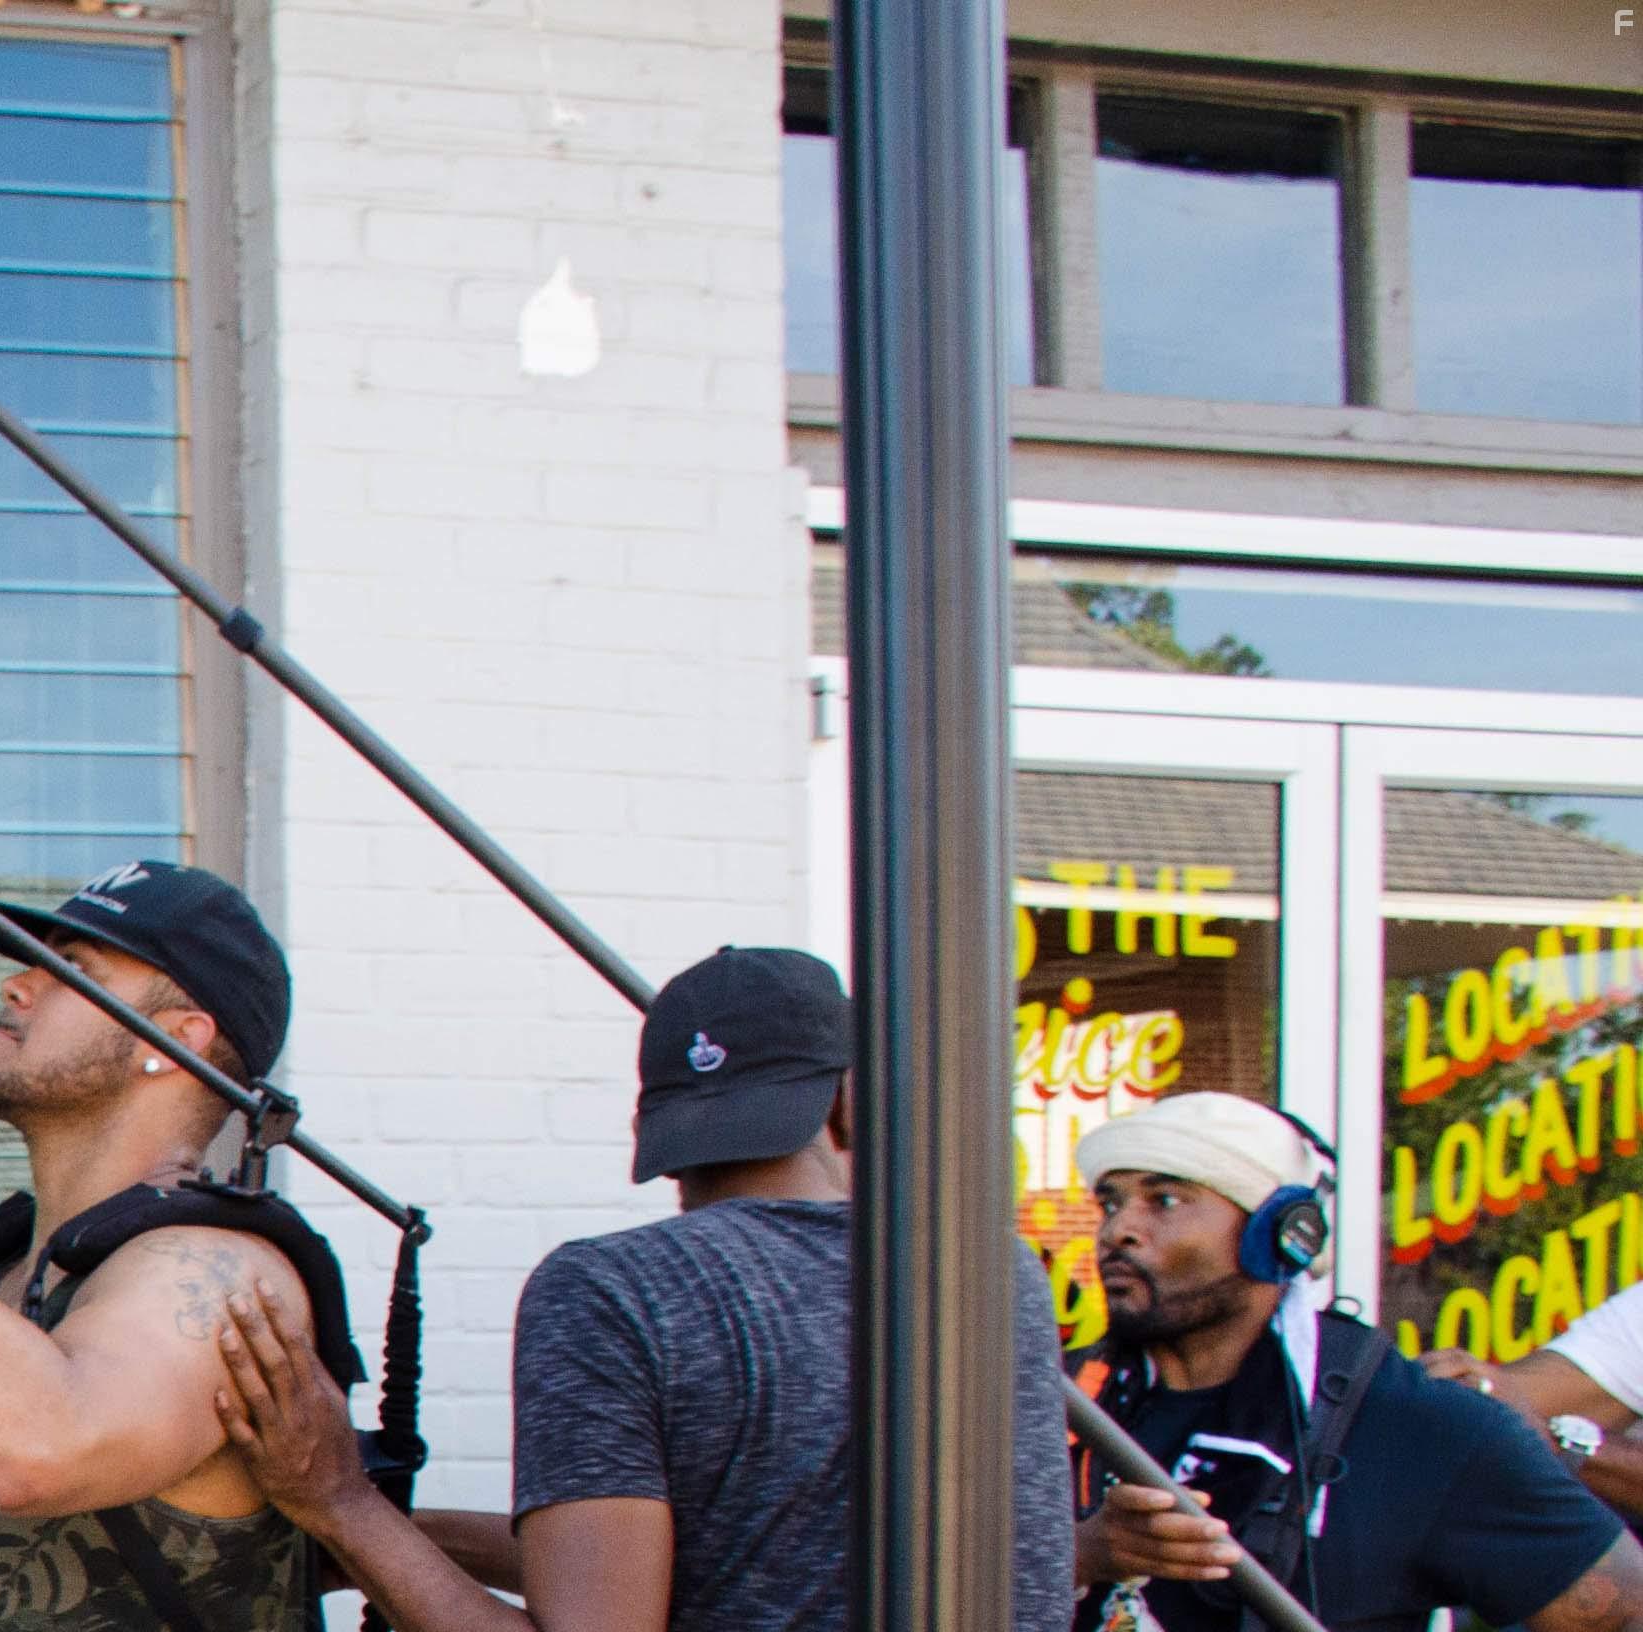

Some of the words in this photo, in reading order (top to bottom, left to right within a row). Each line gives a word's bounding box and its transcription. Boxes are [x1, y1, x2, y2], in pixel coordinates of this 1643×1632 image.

[1048, 862, 1238, 958] THE
[1402, 892, 1643, 1091] LOCATI
[1392, 1041, 1643, 1248] LOCATI
[1397, 1191, 1643, 1364] OCATI
